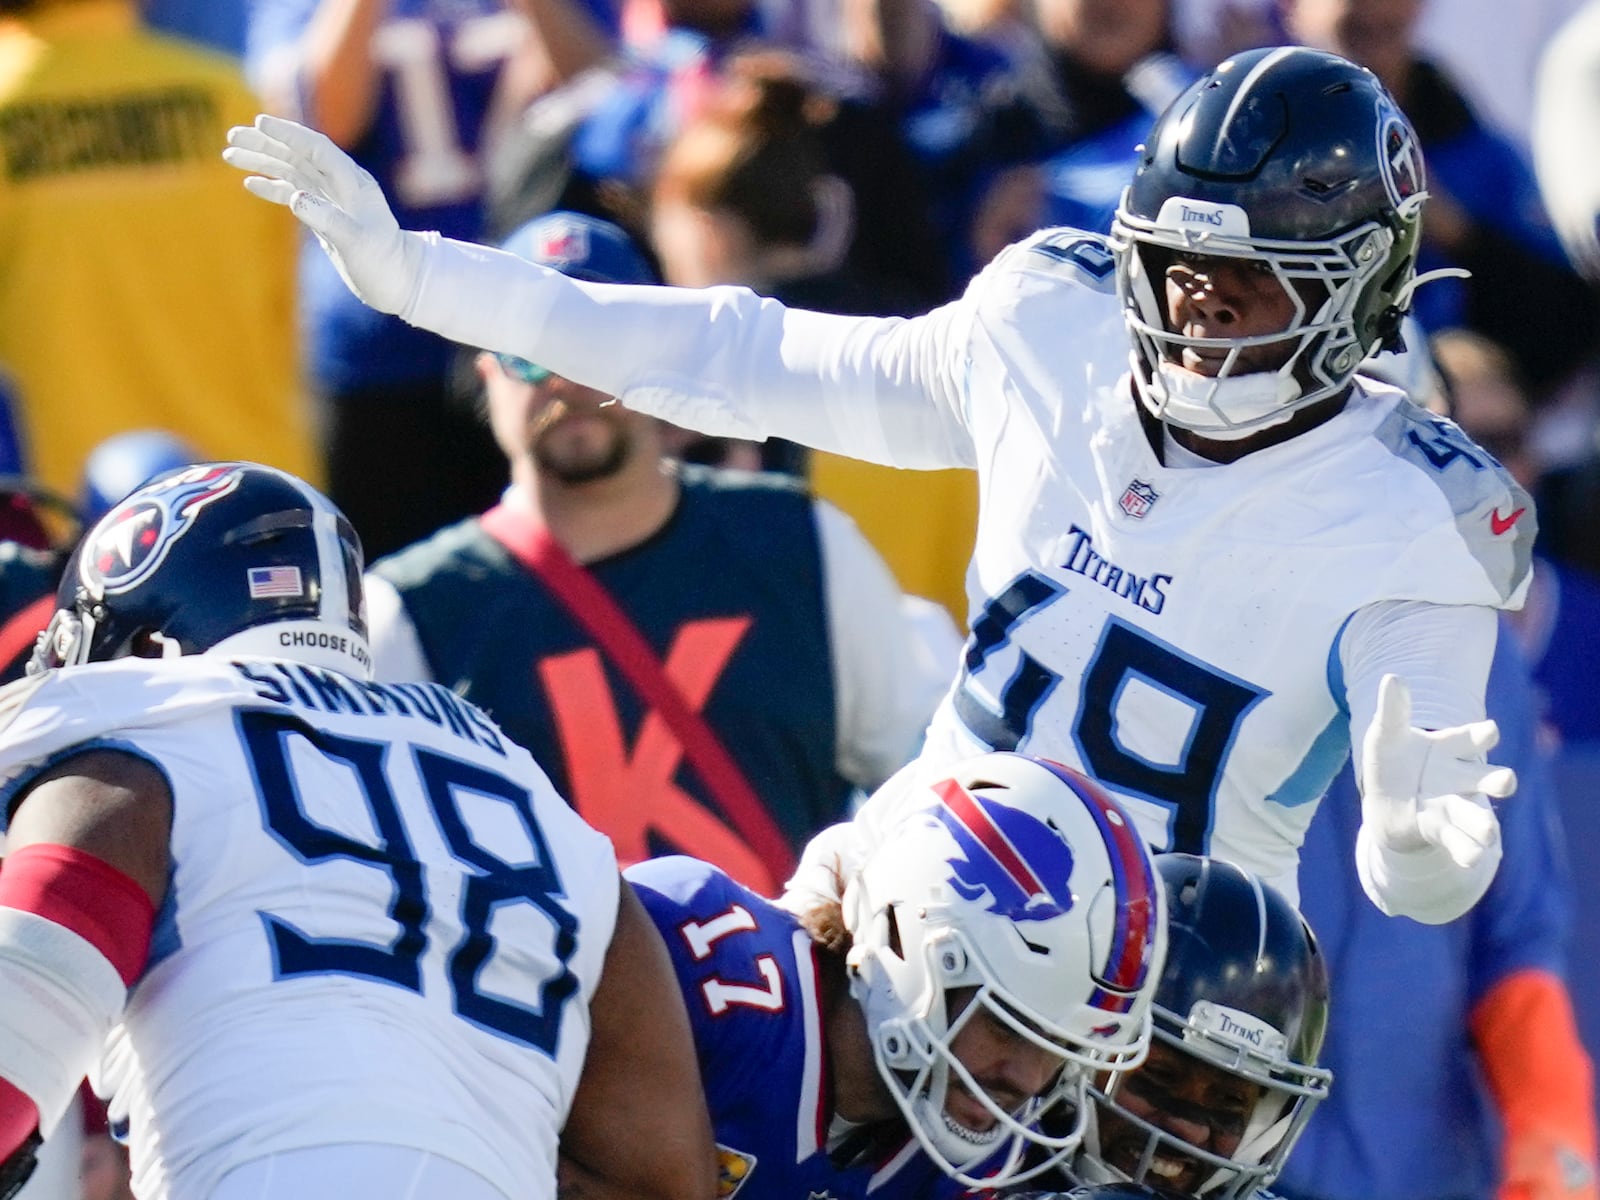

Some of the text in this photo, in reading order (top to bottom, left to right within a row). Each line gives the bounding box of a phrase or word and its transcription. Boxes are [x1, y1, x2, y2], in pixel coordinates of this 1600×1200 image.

[370, 14, 532, 207] 17
[1181, 204, 1224, 227] TITANS
[1060, 523, 1174, 616] TITANS
[280, 631, 348, 654] CHOOSE
[230, 660, 508, 758] SIMMONS
[538, 612, 778, 901] K
[953, 567, 1274, 857] 49
[232, 706, 581, 1063] 98
[679, 902, 785, 1016] 17
[1220, 1012, 1264, 1047] TITANS
